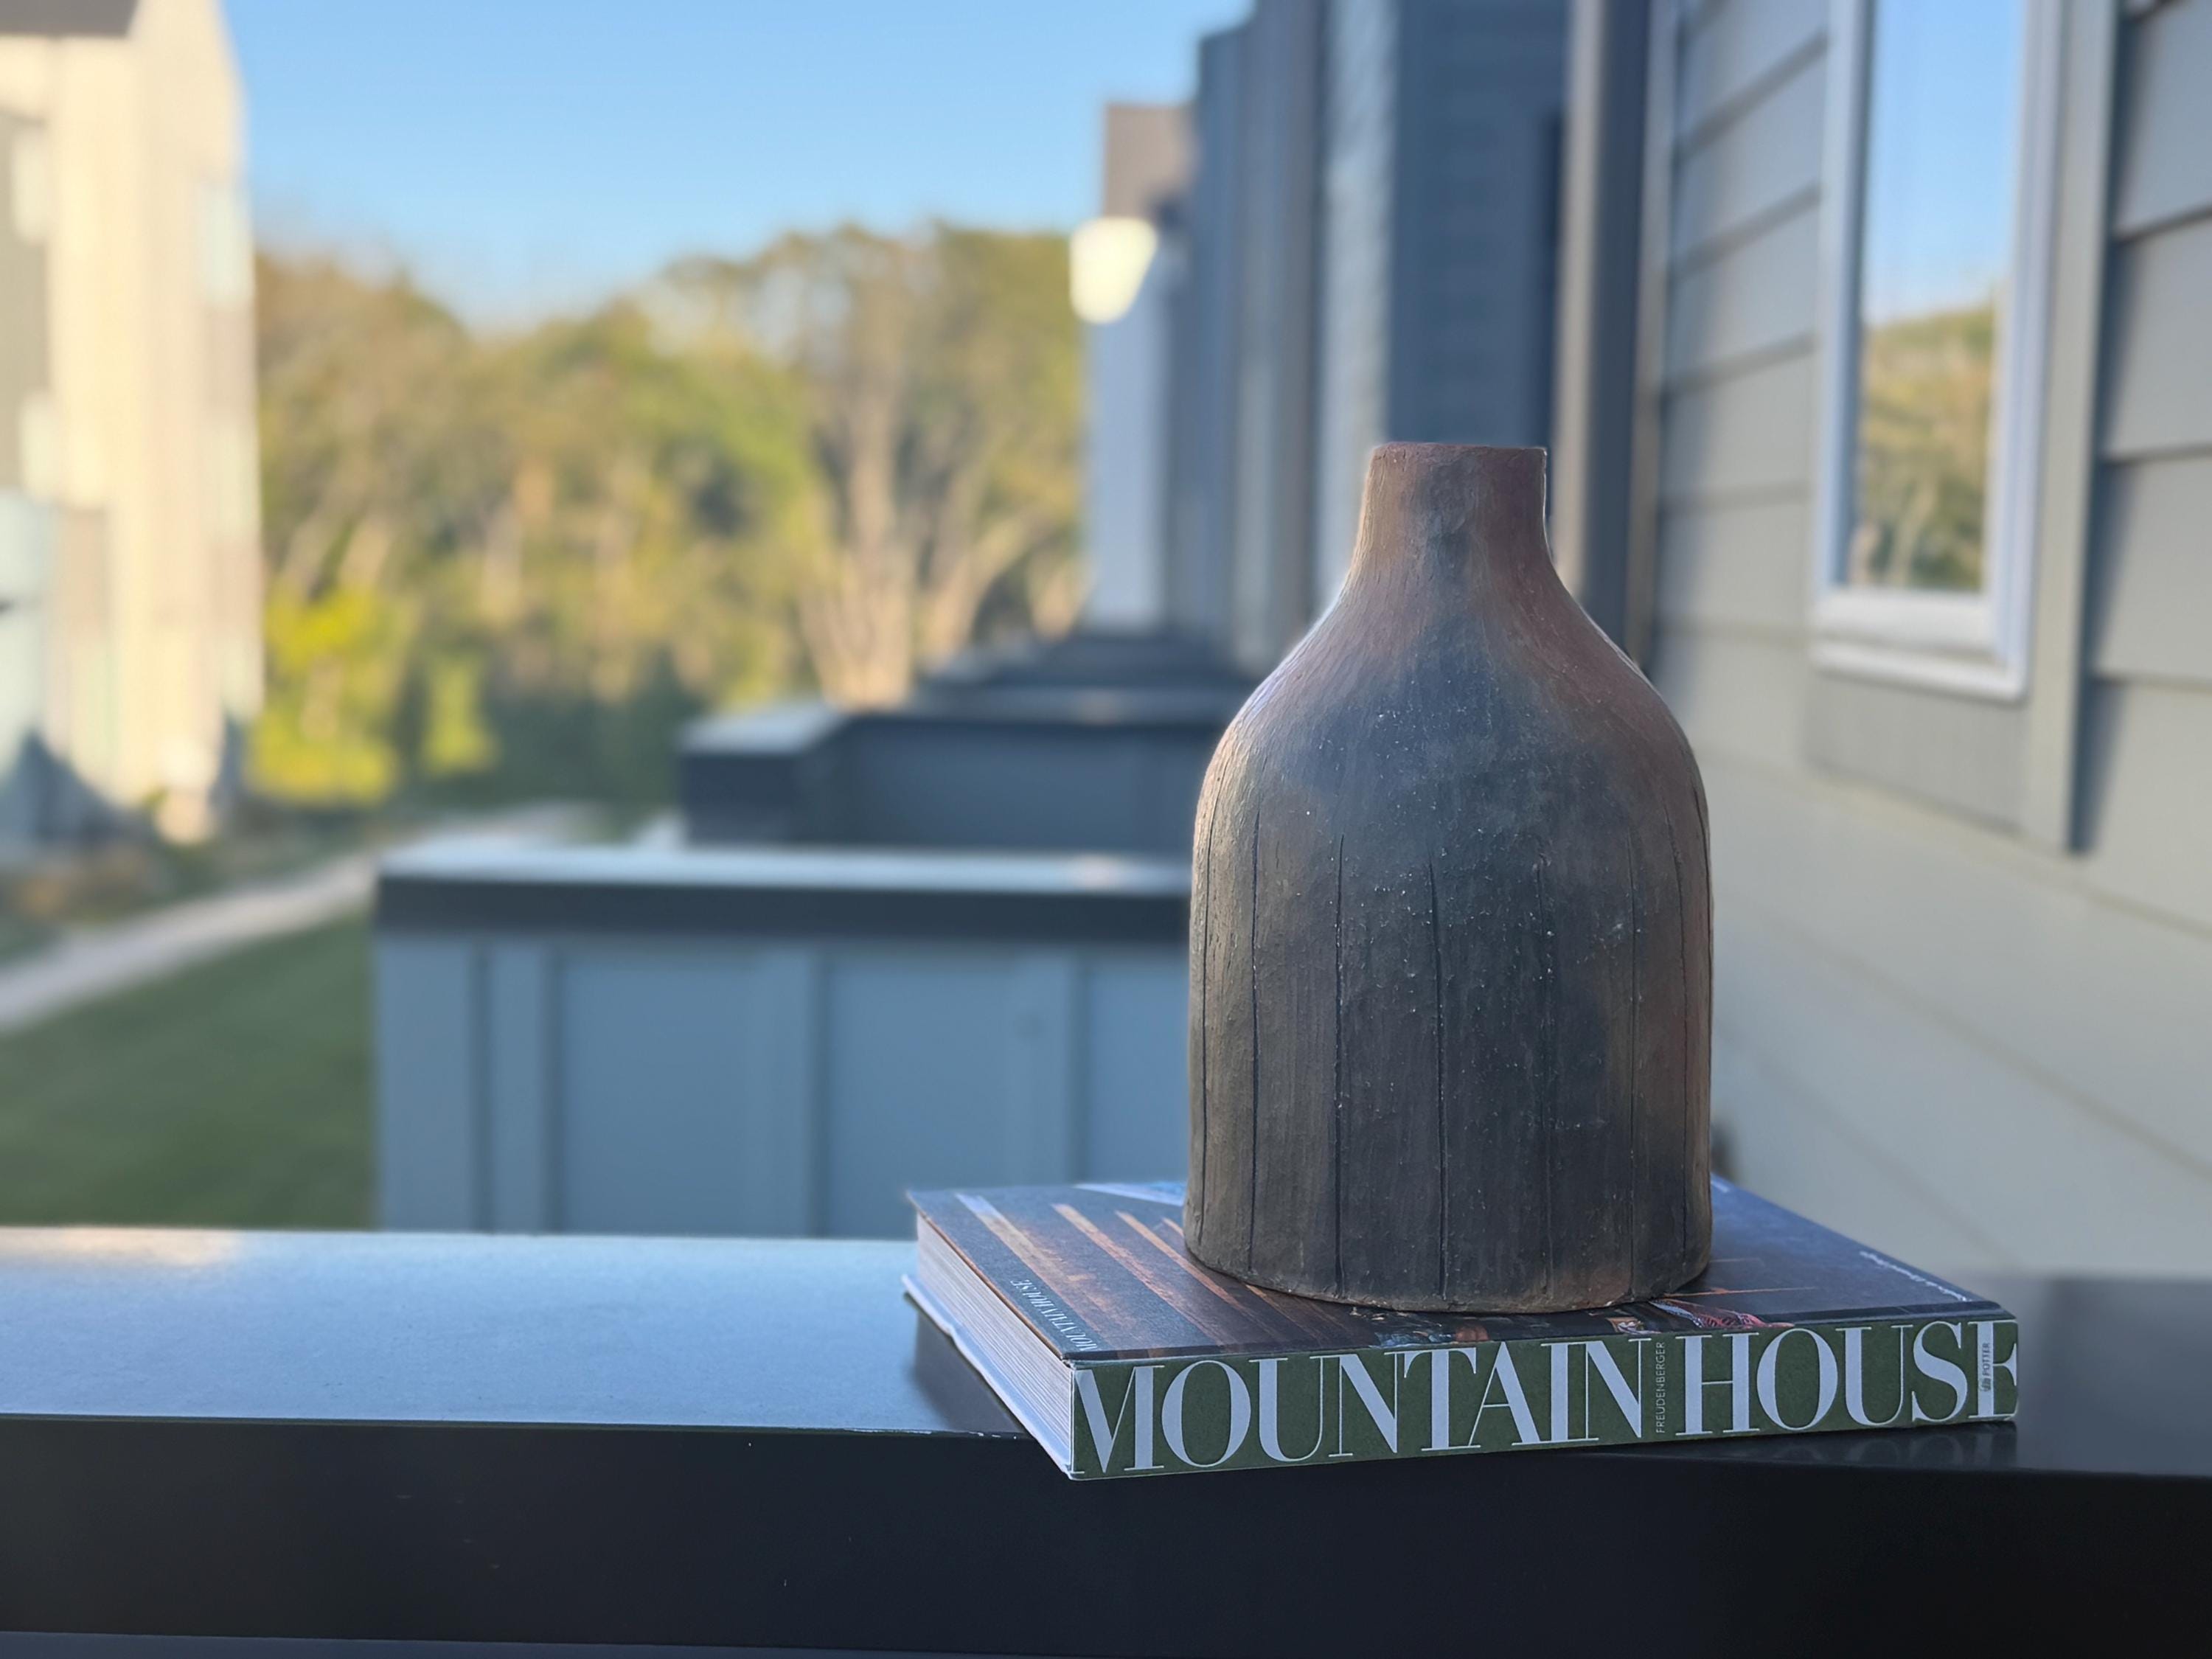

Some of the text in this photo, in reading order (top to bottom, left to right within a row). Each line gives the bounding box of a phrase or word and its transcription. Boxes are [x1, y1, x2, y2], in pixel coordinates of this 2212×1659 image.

[1068, 1319, 2018, 1474] MOUNTAIN HOUSE
[1655, 1342, 1666, 1433] FREUDENBERGER
[1981, 1343, 1990, 1376] POTTER
